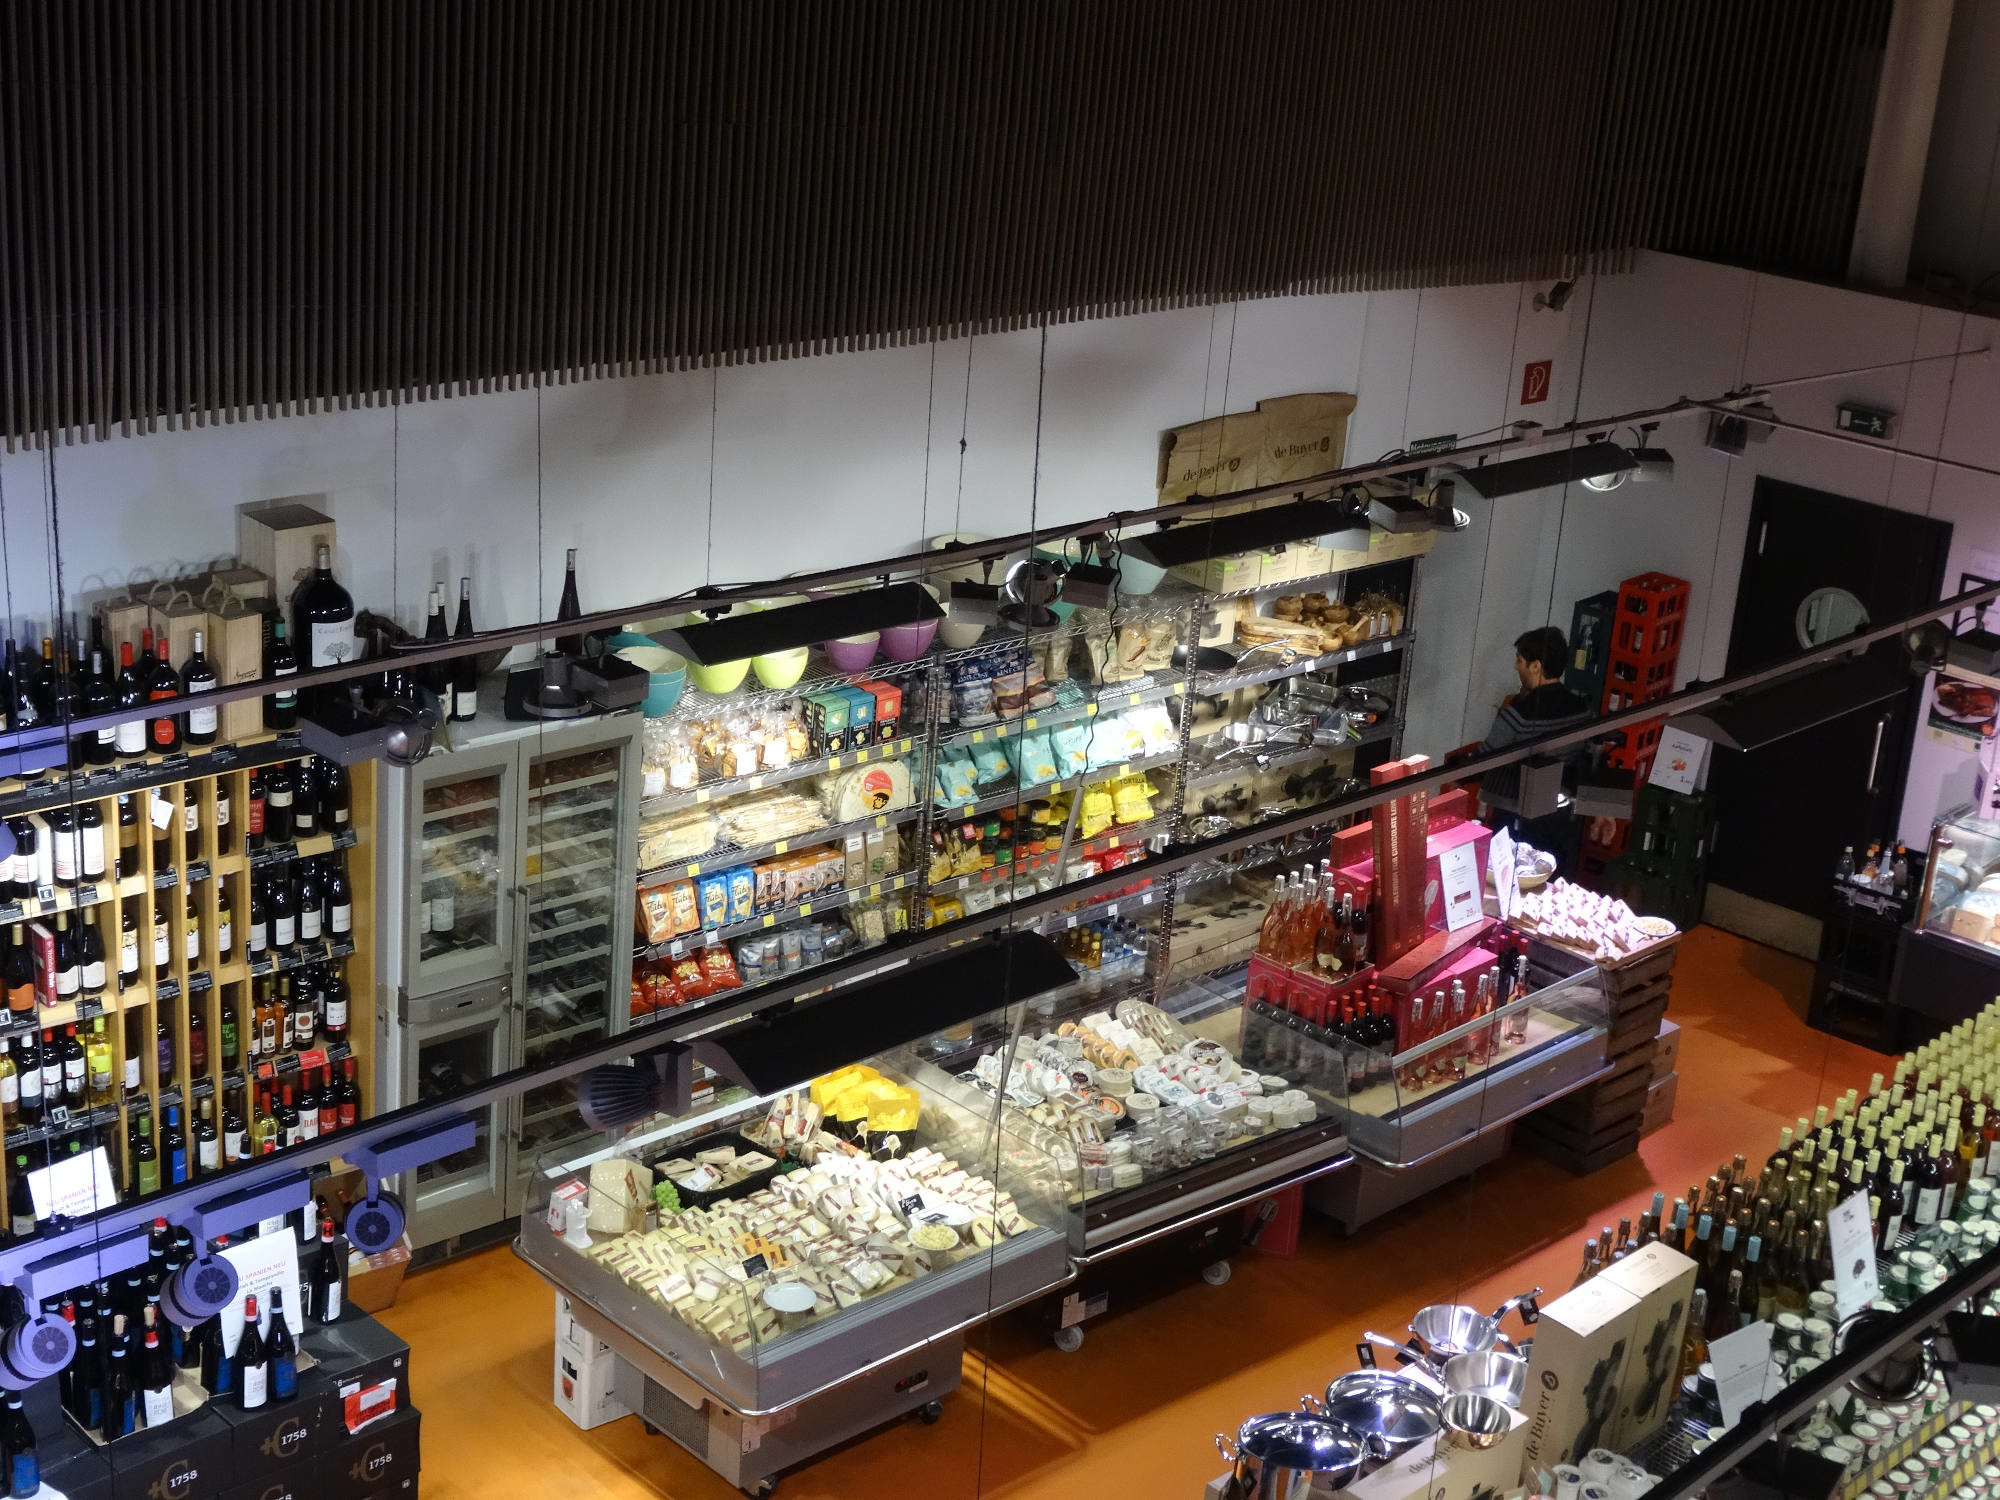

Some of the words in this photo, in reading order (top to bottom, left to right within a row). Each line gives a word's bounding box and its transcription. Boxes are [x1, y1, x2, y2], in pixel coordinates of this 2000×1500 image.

[1390, 816, 1399, 857] CHOCOLATE
[1530, 1391, 1552, 1441] Buyer
[280, 1427, 307, 1446] 1758
[1525, 1440, 1540, 1461] de
[368, 1453, 393, 1471] 1758
[169, 1469, 198, 1489] 1758
